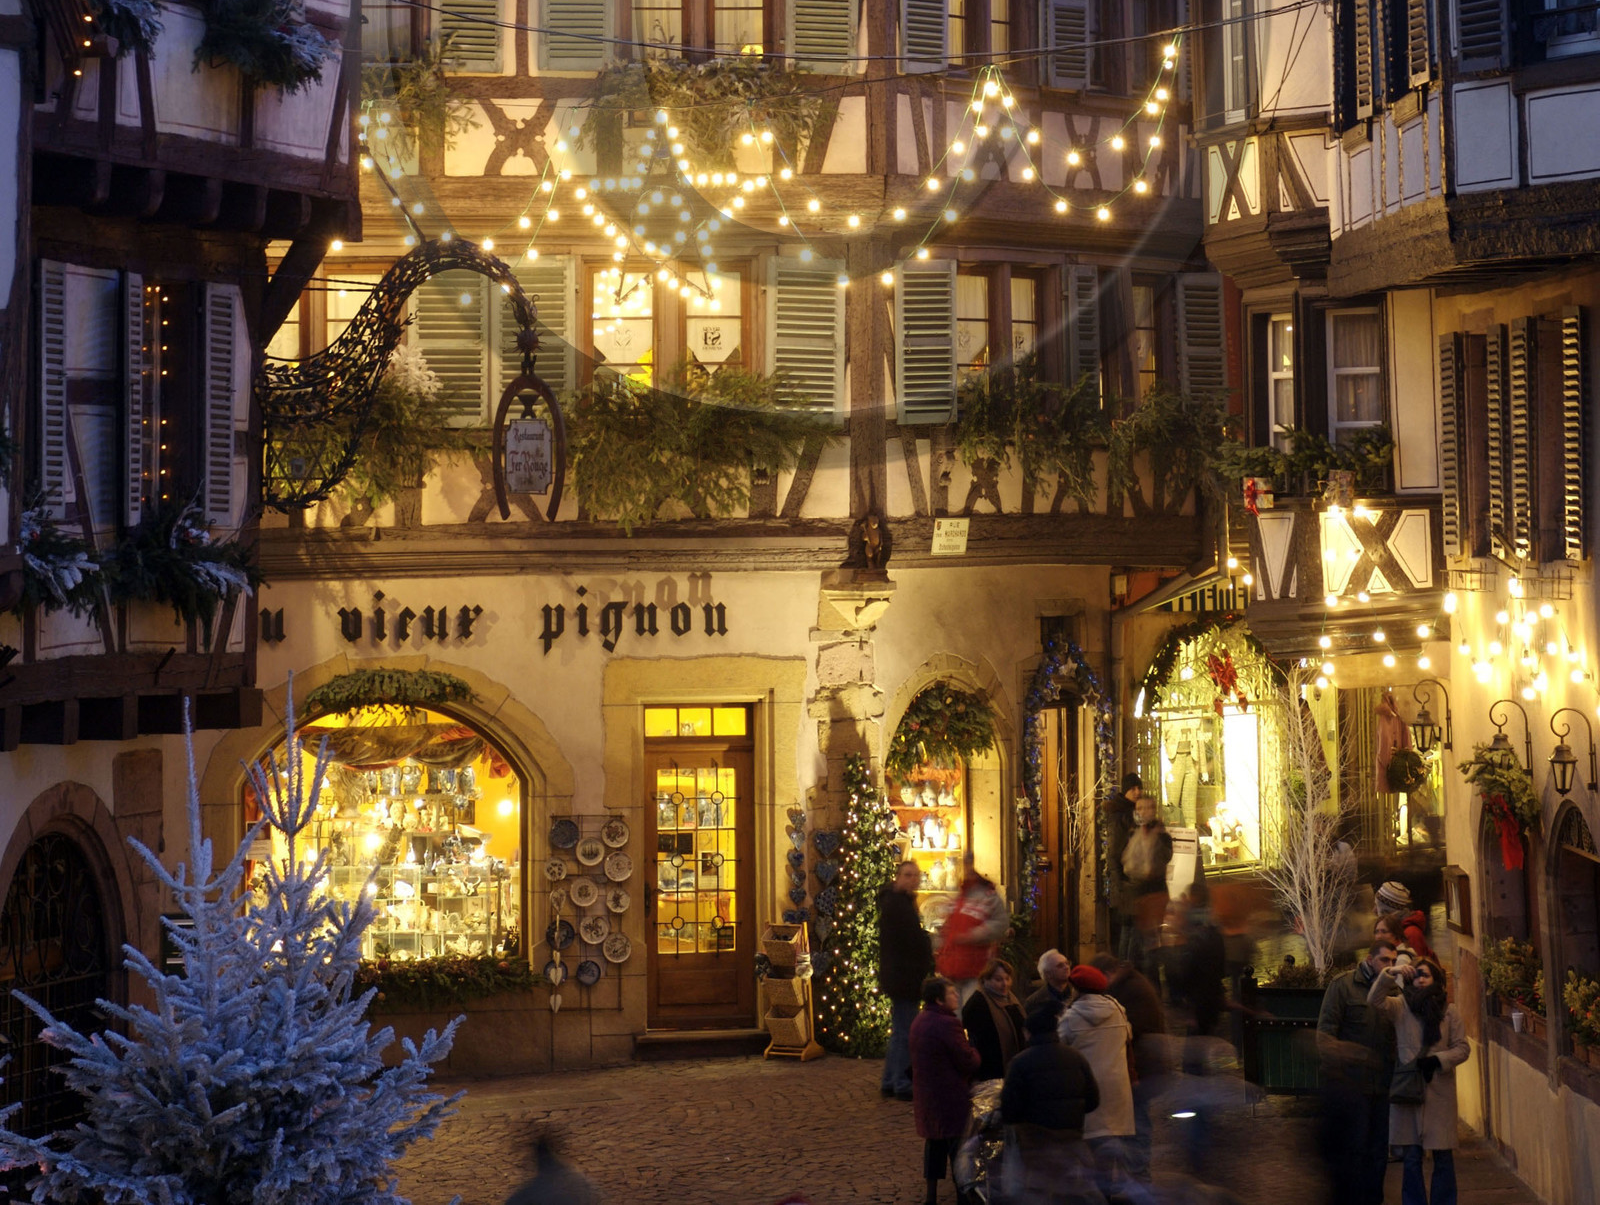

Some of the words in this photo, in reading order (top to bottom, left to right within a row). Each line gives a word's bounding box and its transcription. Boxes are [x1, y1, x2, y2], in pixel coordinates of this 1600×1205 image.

[508, 450, 523, 475] Fer
[337, 590, 484, 643] vieux
[538, 585, 728, 656] pignon
